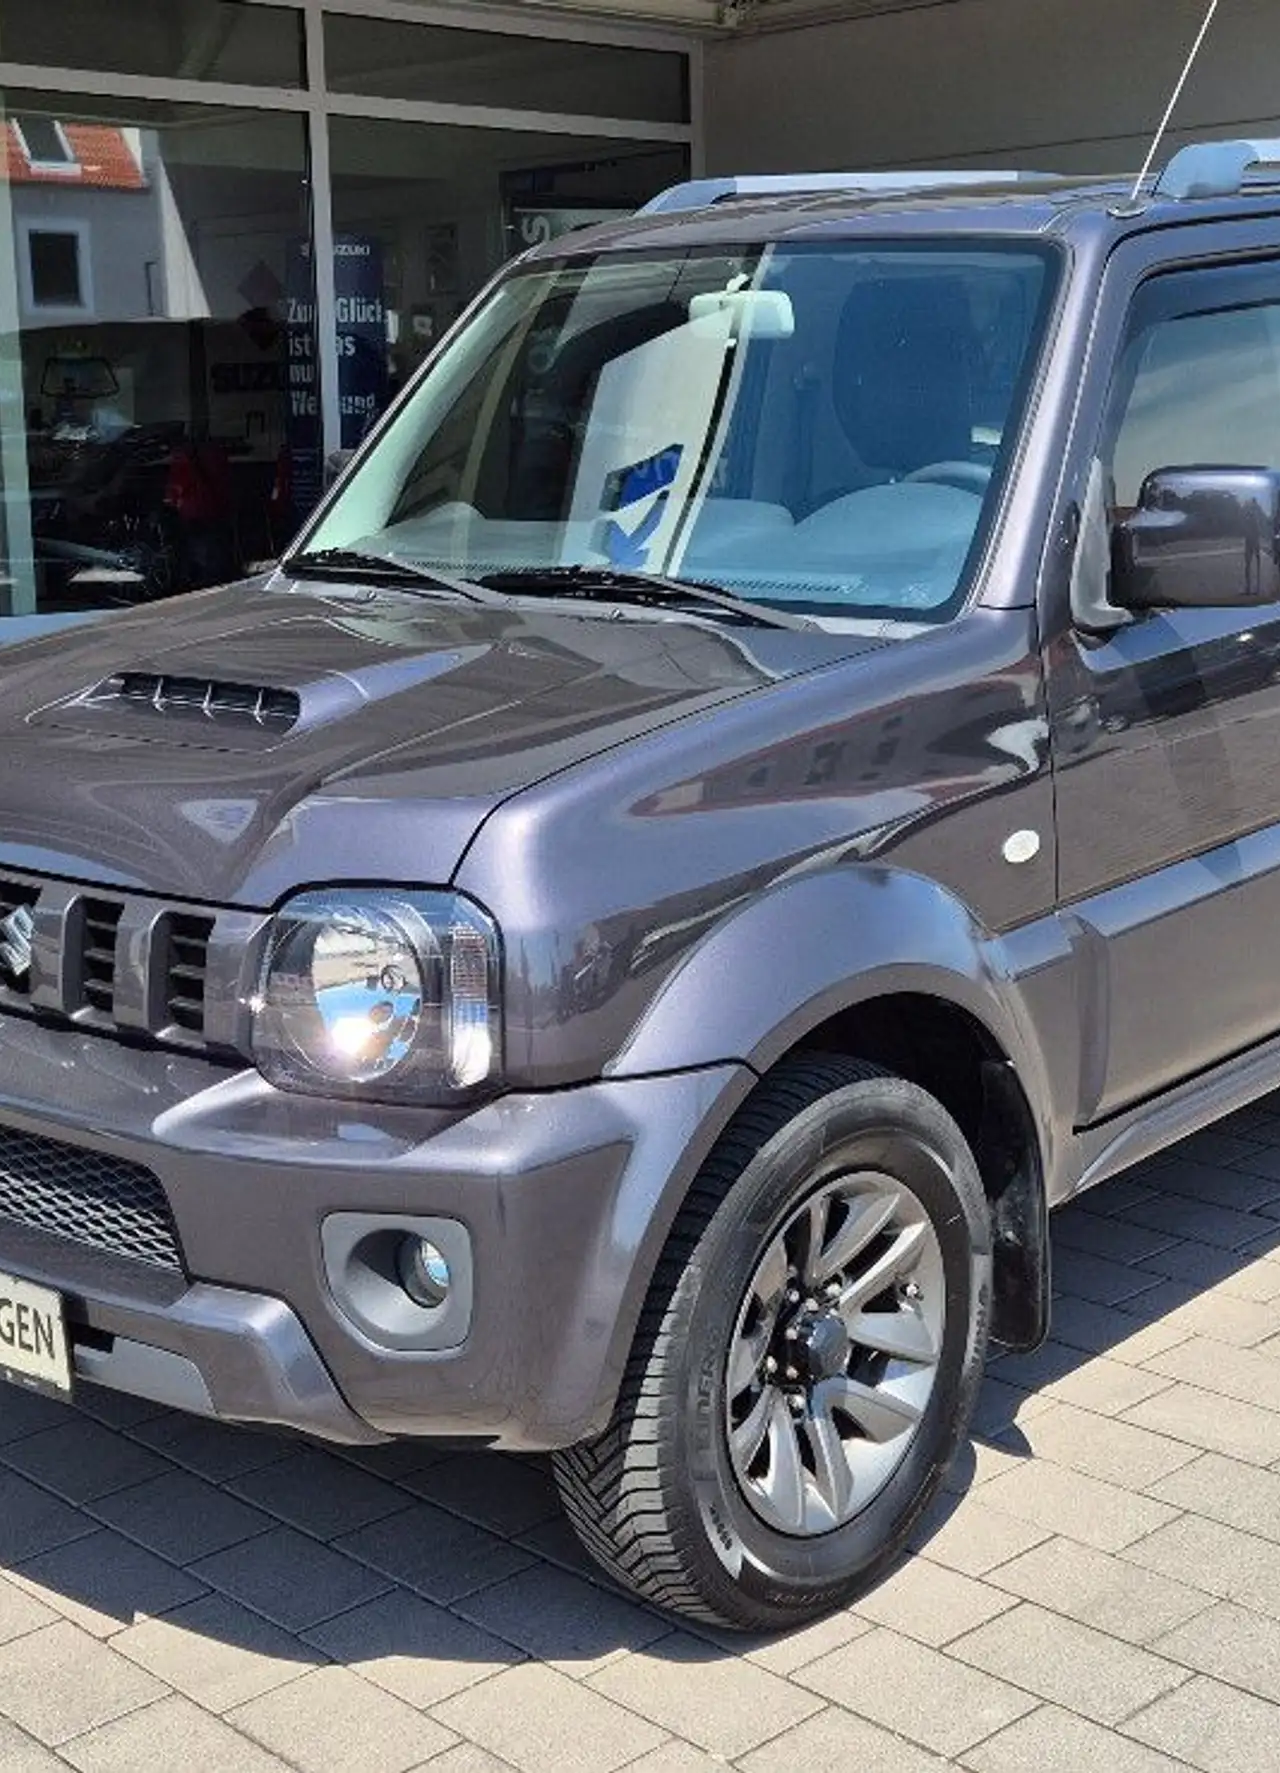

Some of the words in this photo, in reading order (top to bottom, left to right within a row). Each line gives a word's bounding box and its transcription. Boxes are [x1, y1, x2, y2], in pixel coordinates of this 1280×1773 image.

[289, 331, 311, 357] ist
[335, 334, 356, 357] as
[289, 364, 315, 383] nu
